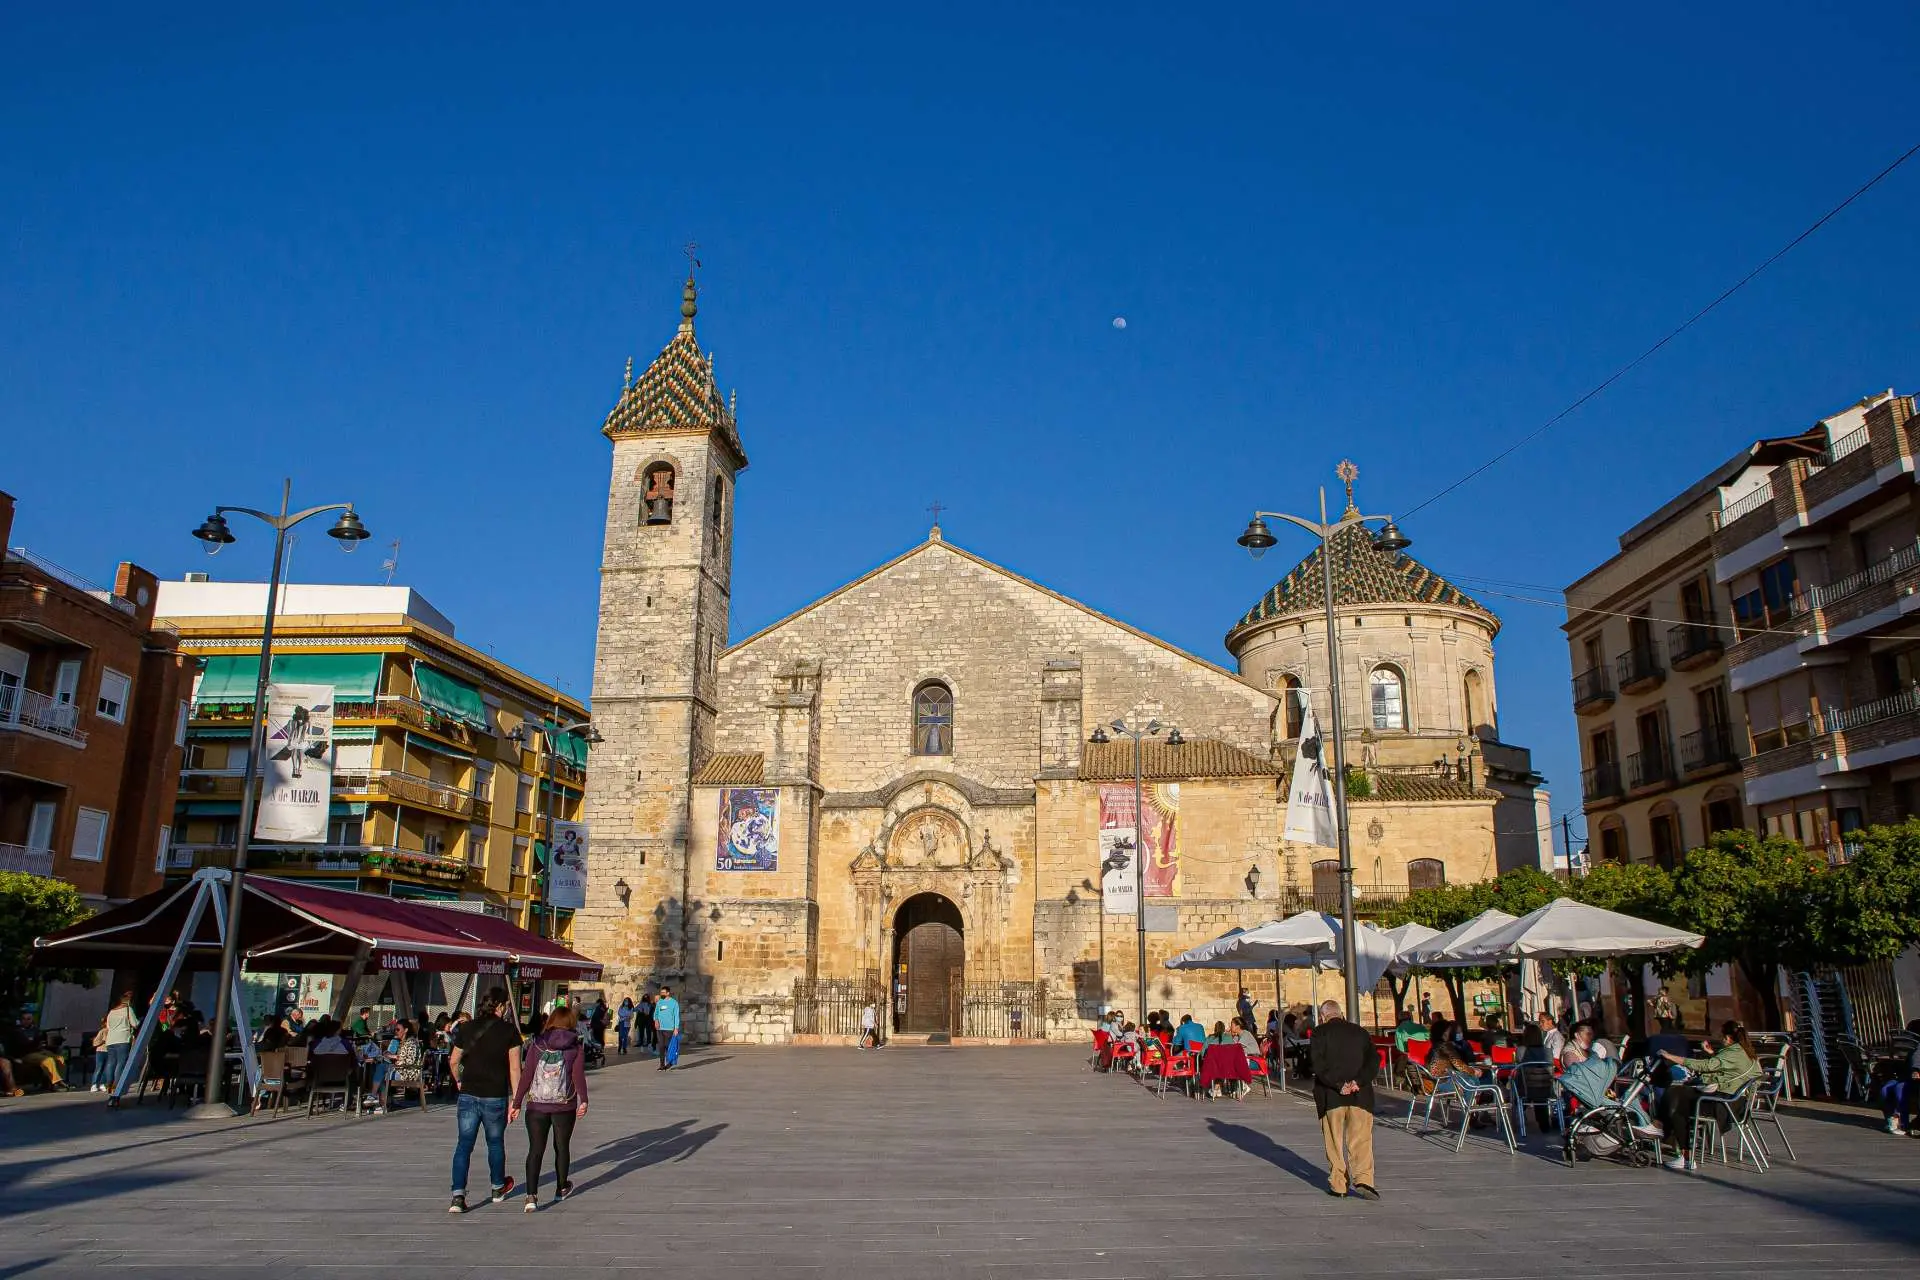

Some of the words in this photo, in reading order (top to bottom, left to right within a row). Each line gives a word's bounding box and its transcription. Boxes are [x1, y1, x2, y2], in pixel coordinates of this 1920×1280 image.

[279, 787, 288, 802] de
[1304, 791, 1313, 804] de
[717, 857, 733, 870] 50
[382, 952, 420, 970] alacant
[521, 965, 543, 979] alacant
